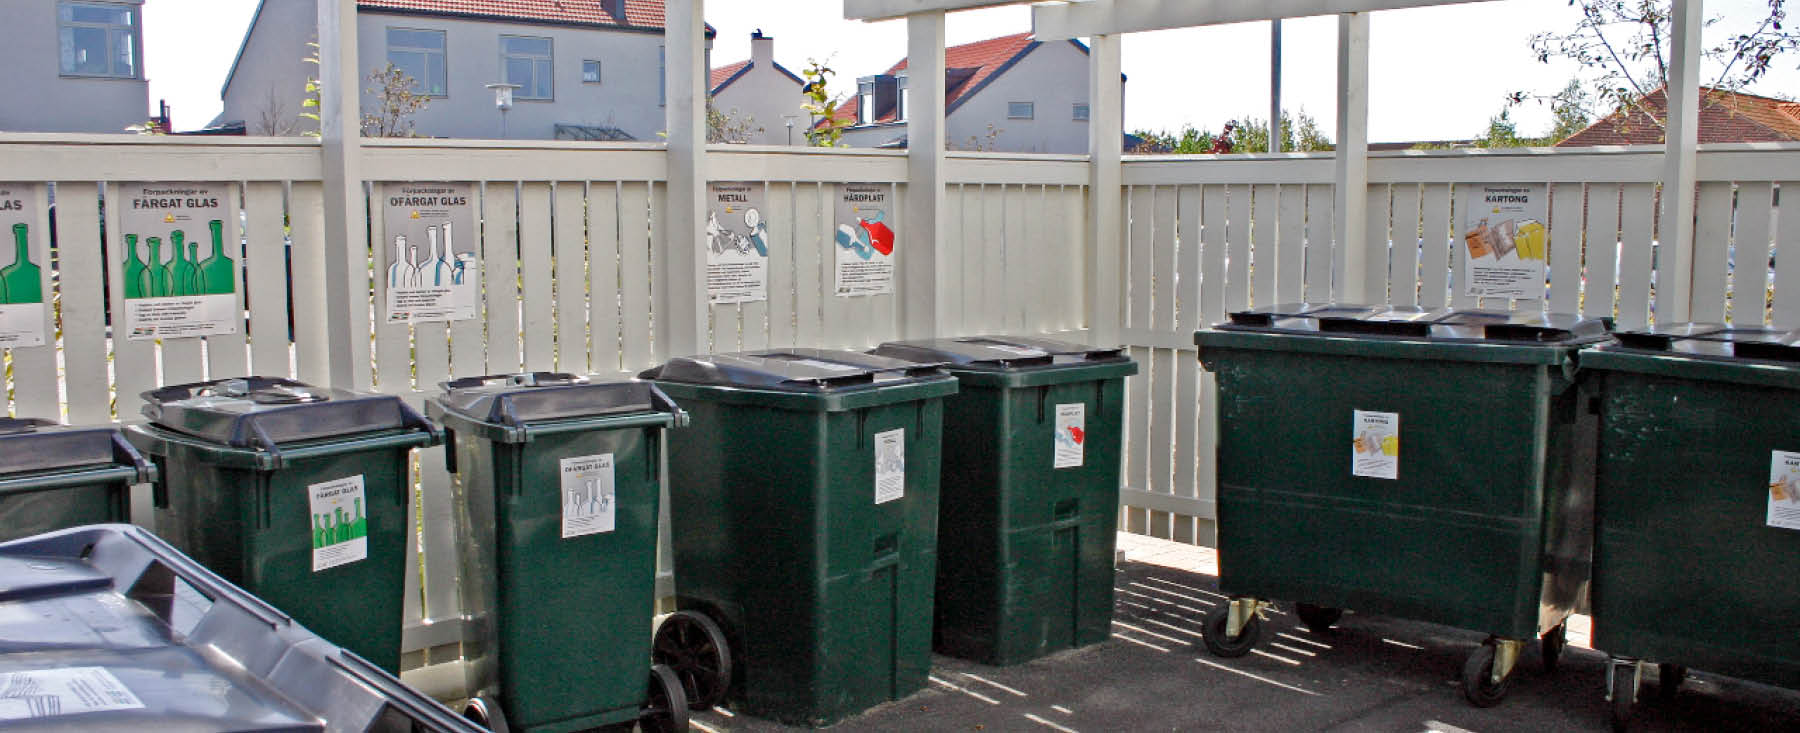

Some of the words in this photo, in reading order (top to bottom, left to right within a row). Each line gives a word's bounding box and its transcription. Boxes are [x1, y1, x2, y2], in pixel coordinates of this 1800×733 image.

[440, 197, 466, 206] GLAS
[718, 194, 748, 202] METALL
[1485, 195, 1528, 203] KARTONG
[186, 199, 218, 209] GLAS
